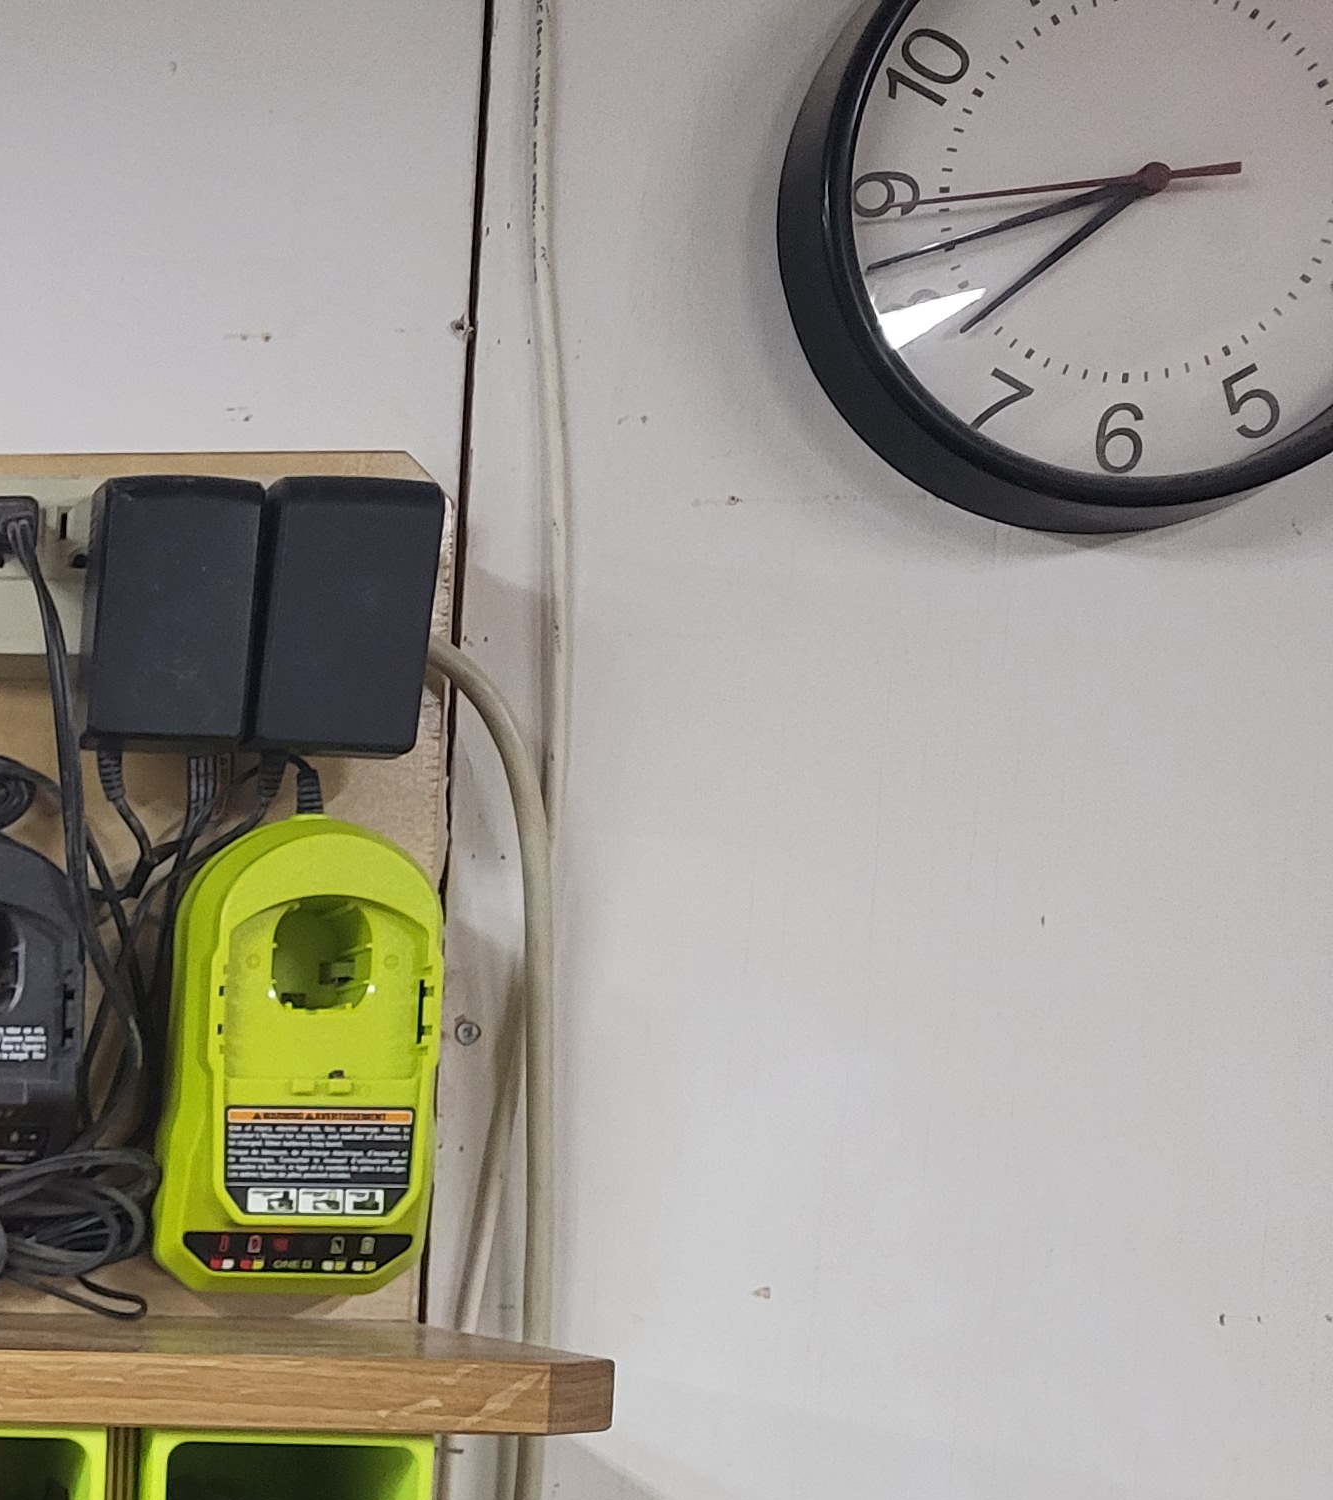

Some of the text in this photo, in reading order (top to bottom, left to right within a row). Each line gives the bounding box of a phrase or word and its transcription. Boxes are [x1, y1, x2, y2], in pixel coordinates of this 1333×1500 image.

[886, 28, 970, 107] 10
[853, 171, 921, 218] 9
[968, 367, 1034, 430] 7
[1222, 363, 1280, 439] 5
[1095, 402, 1144, 474] 6
